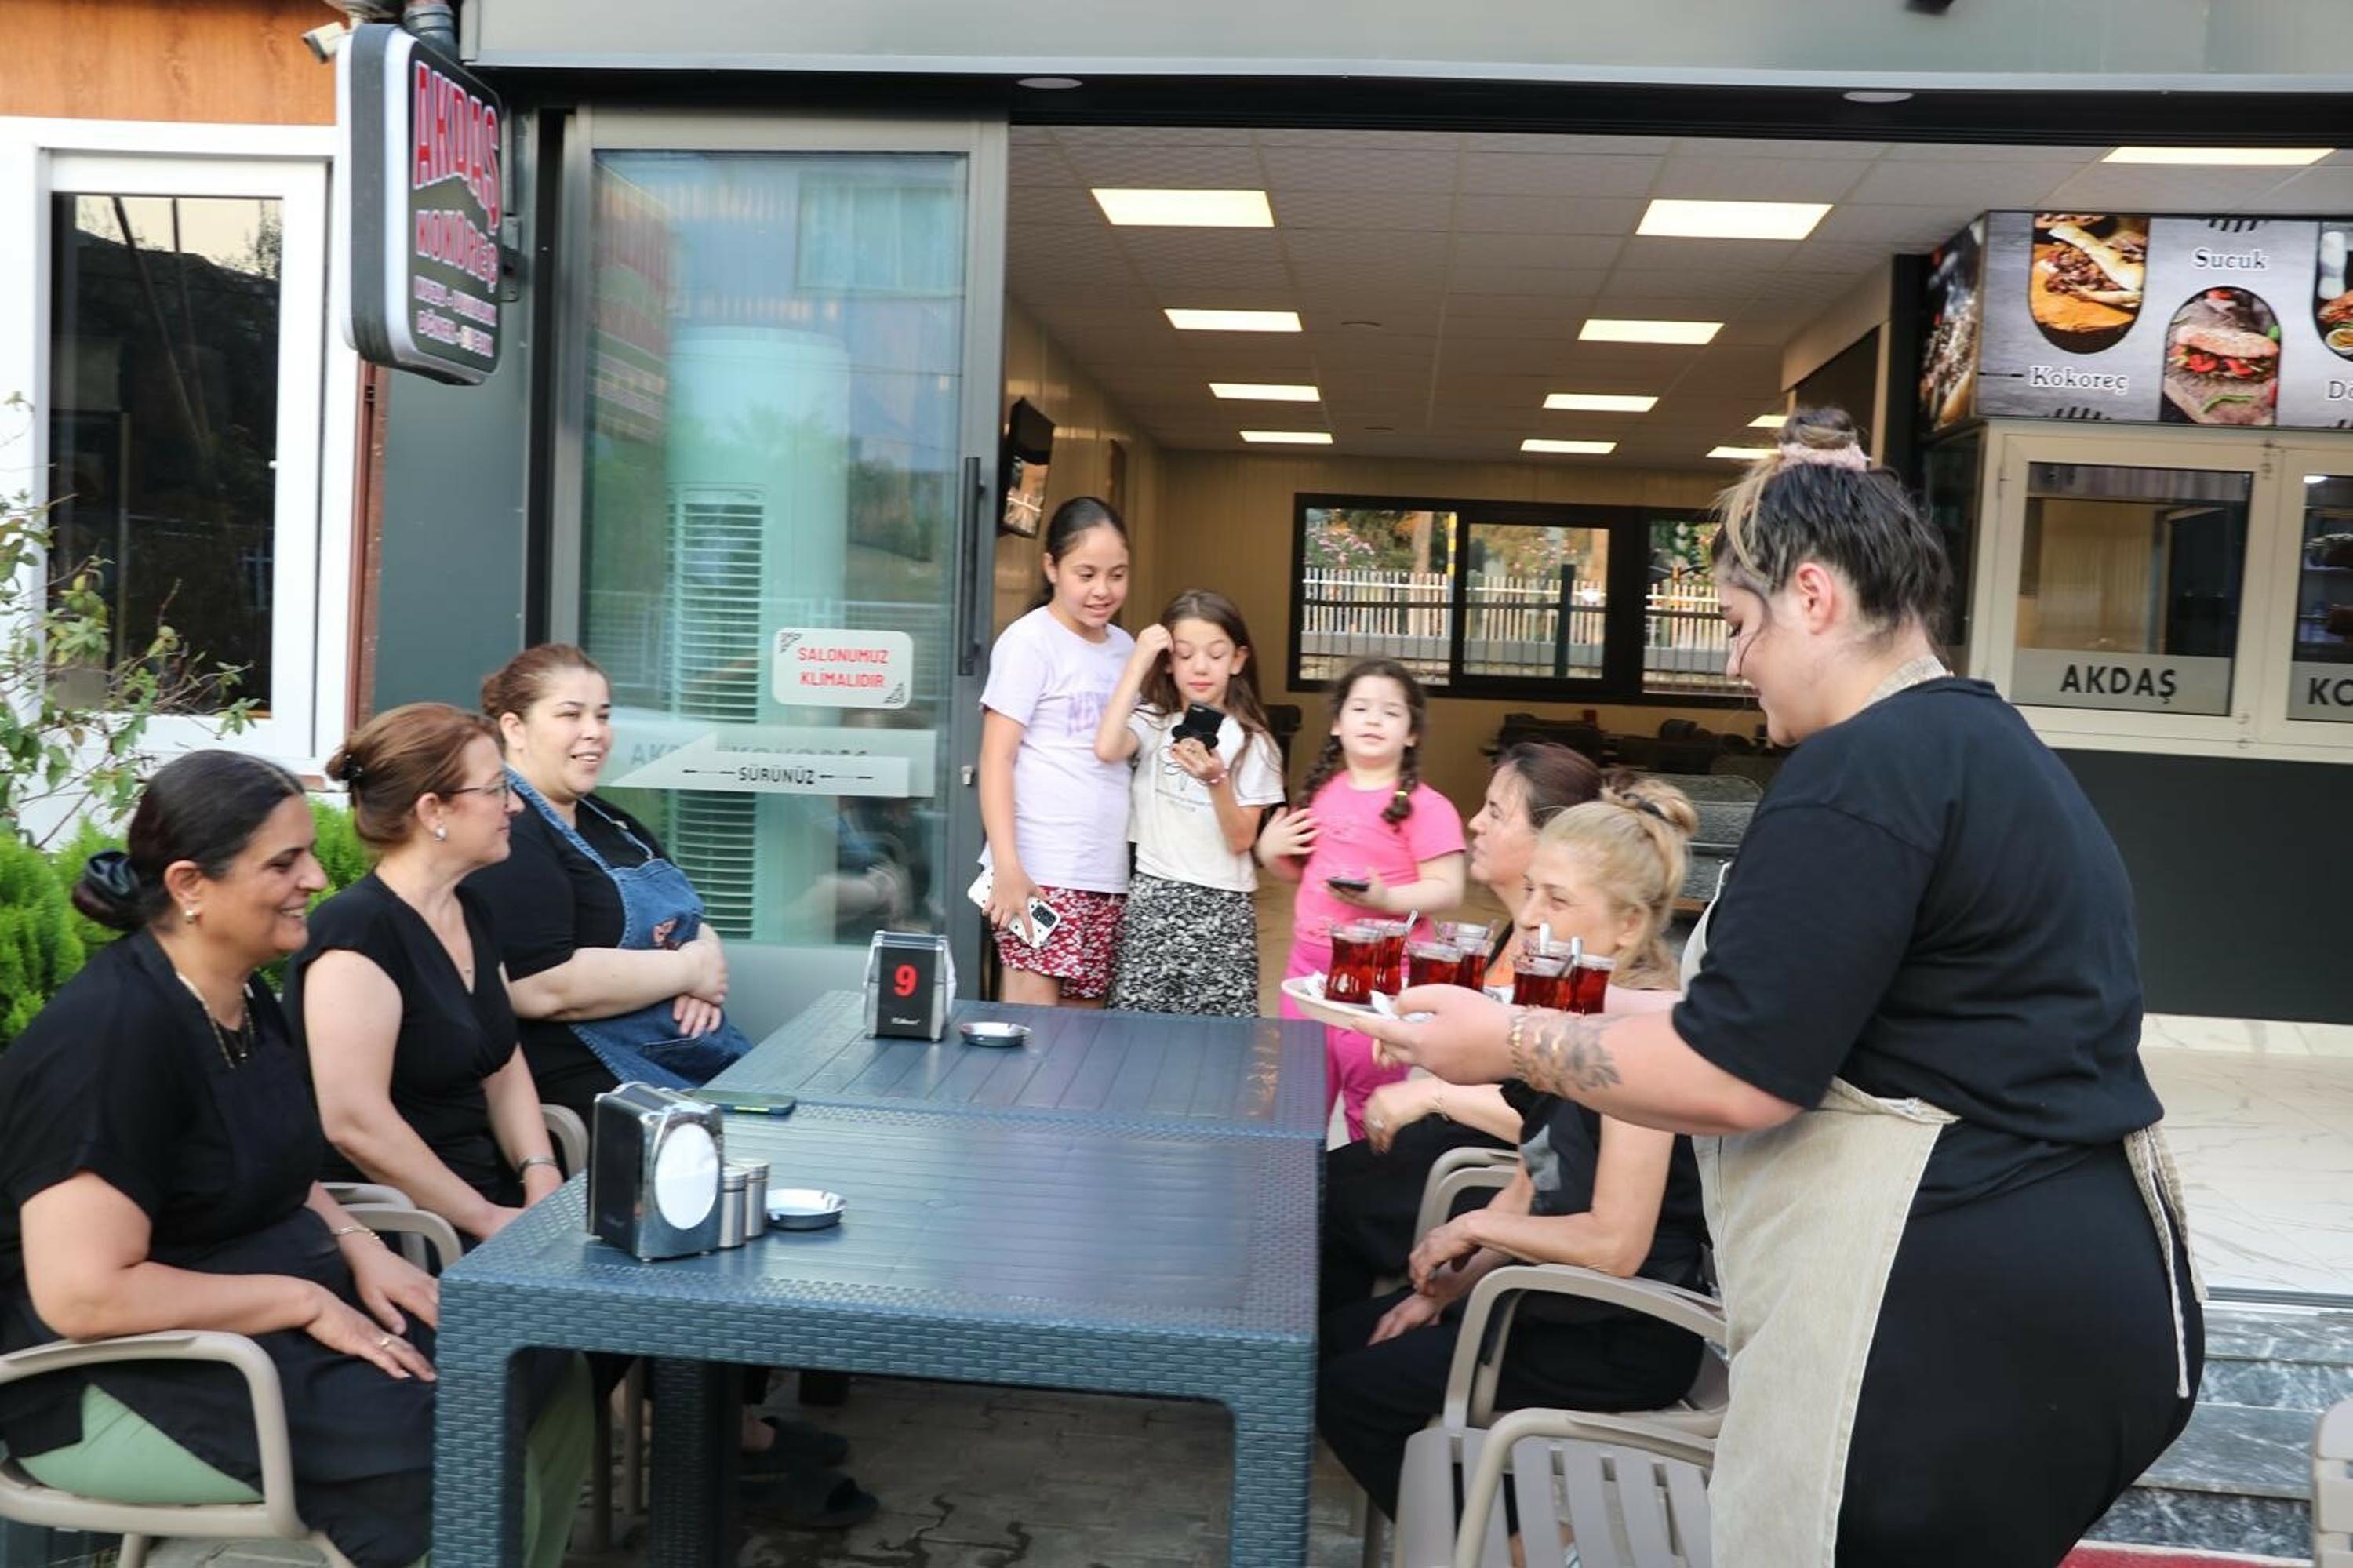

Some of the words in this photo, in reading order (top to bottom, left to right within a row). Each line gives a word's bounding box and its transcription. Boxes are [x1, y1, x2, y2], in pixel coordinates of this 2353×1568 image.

[414, 59, 500, 236] AKDAŞ
[416, 209, 498, 293] KOKOREÇ
[2194, 248, 2268, 270] Sucuk
[2031, 366, 2129, 395] Kokoreç
[798, 646, 889, 664] SALONUMUZ
[799, 668, 885, 688] KLİMALIDIR
[2060, 664, 2178, 705] AKDAŞ
[738, 763, 814, 784] SÜRÜNÜZ
[893, 964, 918, 997] 9
